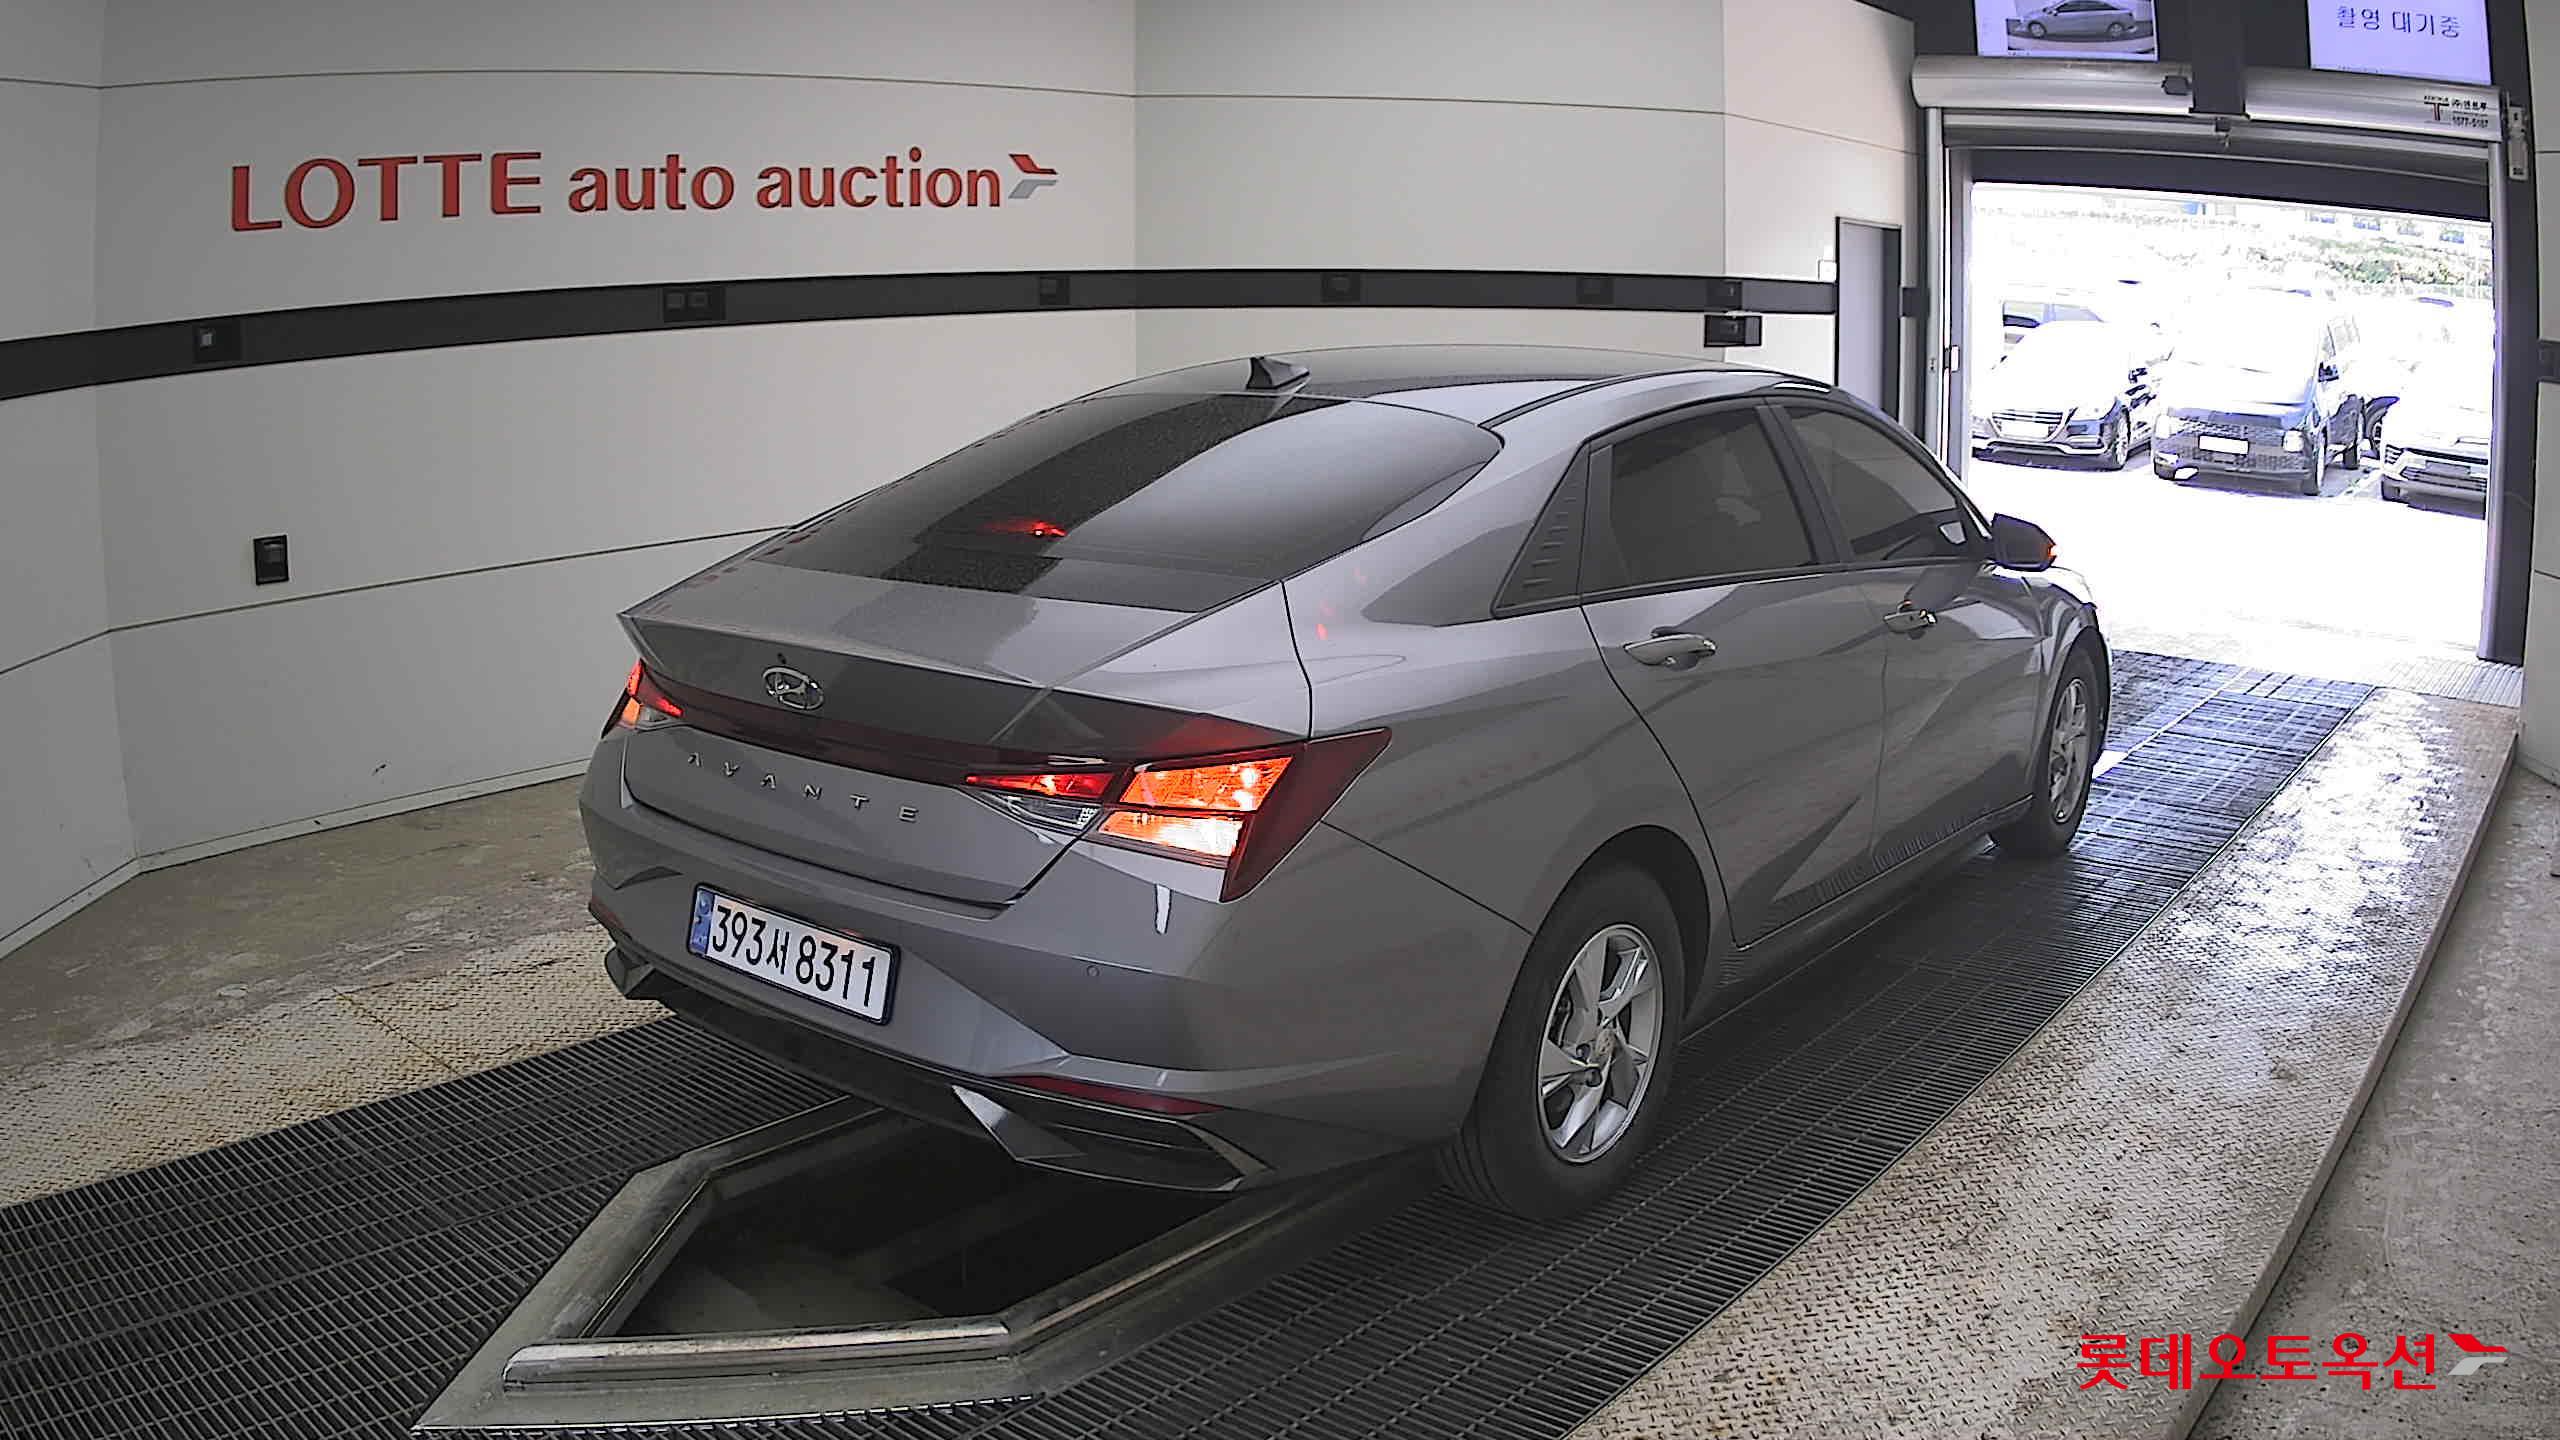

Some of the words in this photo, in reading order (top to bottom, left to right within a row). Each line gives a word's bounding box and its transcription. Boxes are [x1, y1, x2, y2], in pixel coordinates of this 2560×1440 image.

[2338, 6, 2380, 31] 촬영
[2392, 11, 2461, 38] 대기중
[230, 151, 543, 232] LOTTE
[567, 153, 735, 213] auto
[757, 147, 1001, 210] auction
[687, 751, 920, 822] AVANTE
[795, 936, 877, 1007] 8311
